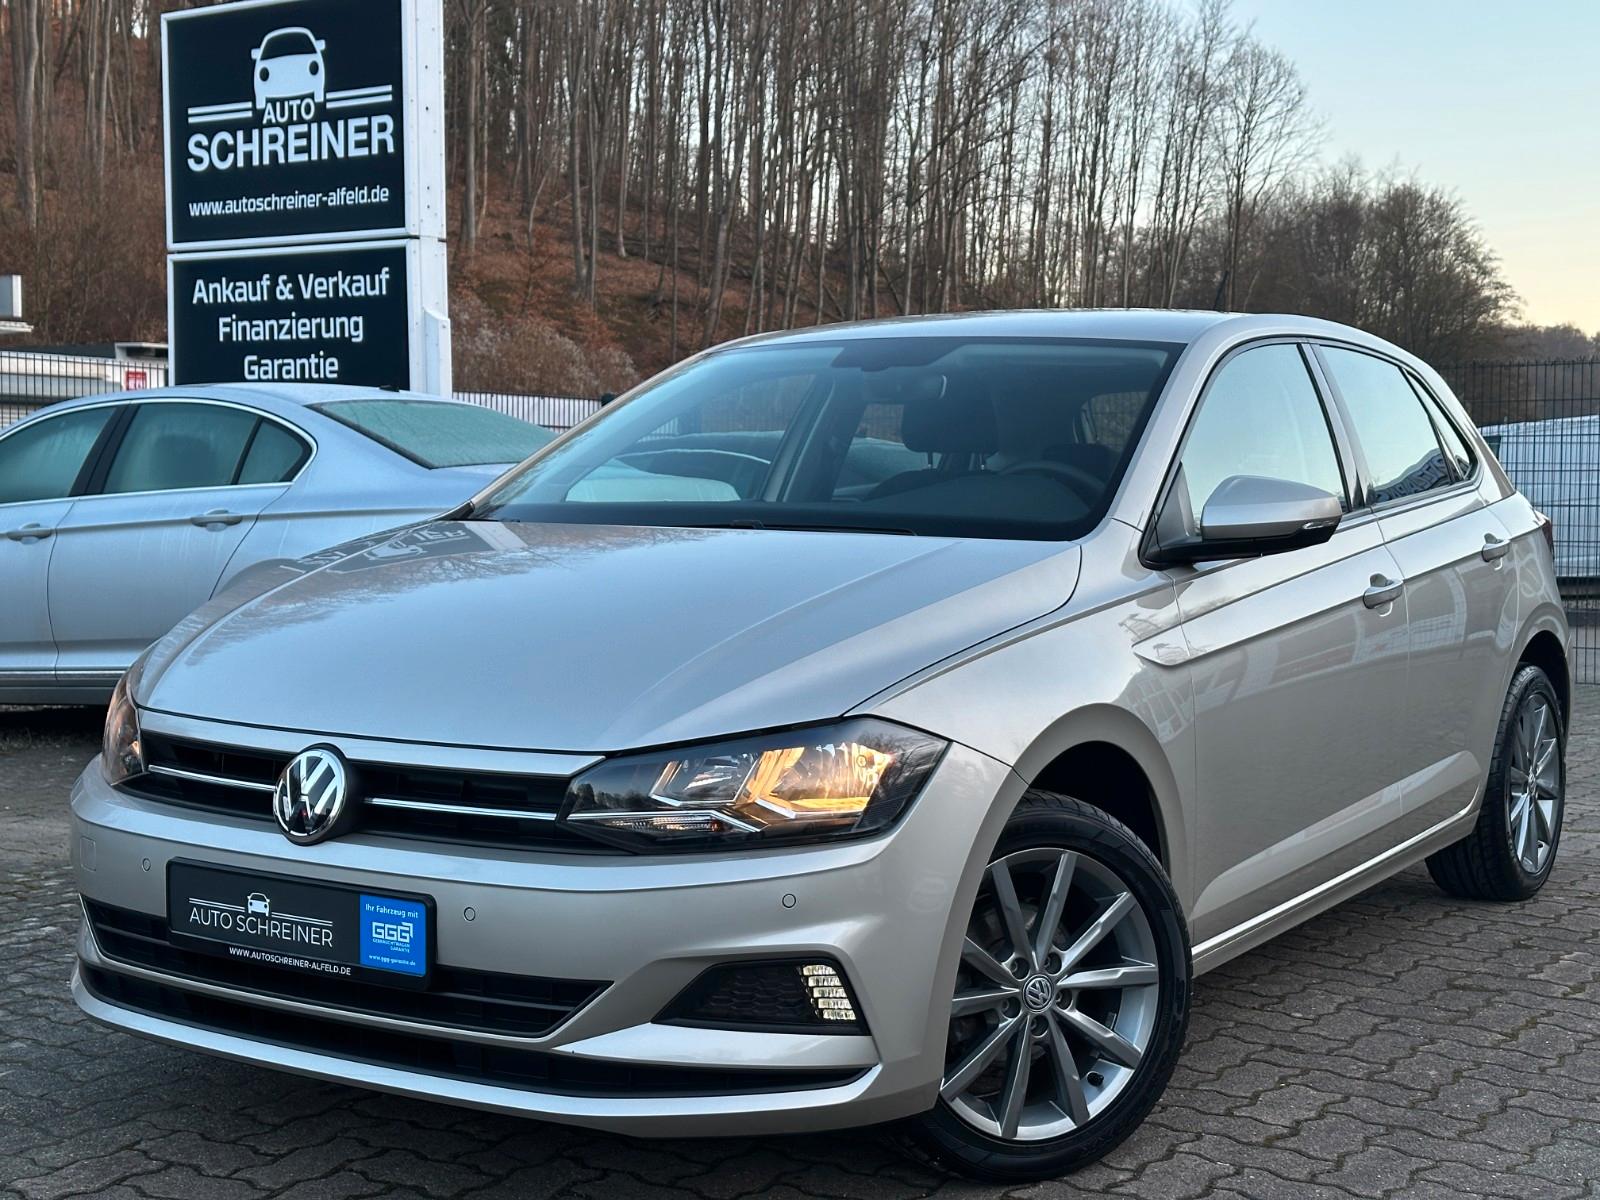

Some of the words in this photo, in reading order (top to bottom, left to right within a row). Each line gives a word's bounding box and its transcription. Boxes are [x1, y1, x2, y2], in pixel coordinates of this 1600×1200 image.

[262, 98, 316, 125] AUTO
[187, 114, 394, 172] SCHREINER
[189, 185, 389, 217] www.autoschreiner-alfeld.de
[192, 274, 270, 304] Ankauf
[275, 274, 294, 300] &
[298, 267, 390, 299] Verkauf
[218, 311, 363, 342] Finanzierung
[243, 351, 338, 380] Garantie
[365, 903, 375, 913] Ihr
[376, 905, 406, 919] Fahrzeug
[407, 911, 419, 919] mit
[189, 907, 233, 929] AUTO
[236, 915, 333, 948] SCHREINER
[229, 946, 351, 976] WWW.AUTOSCHREINER-ALFELD.DE
